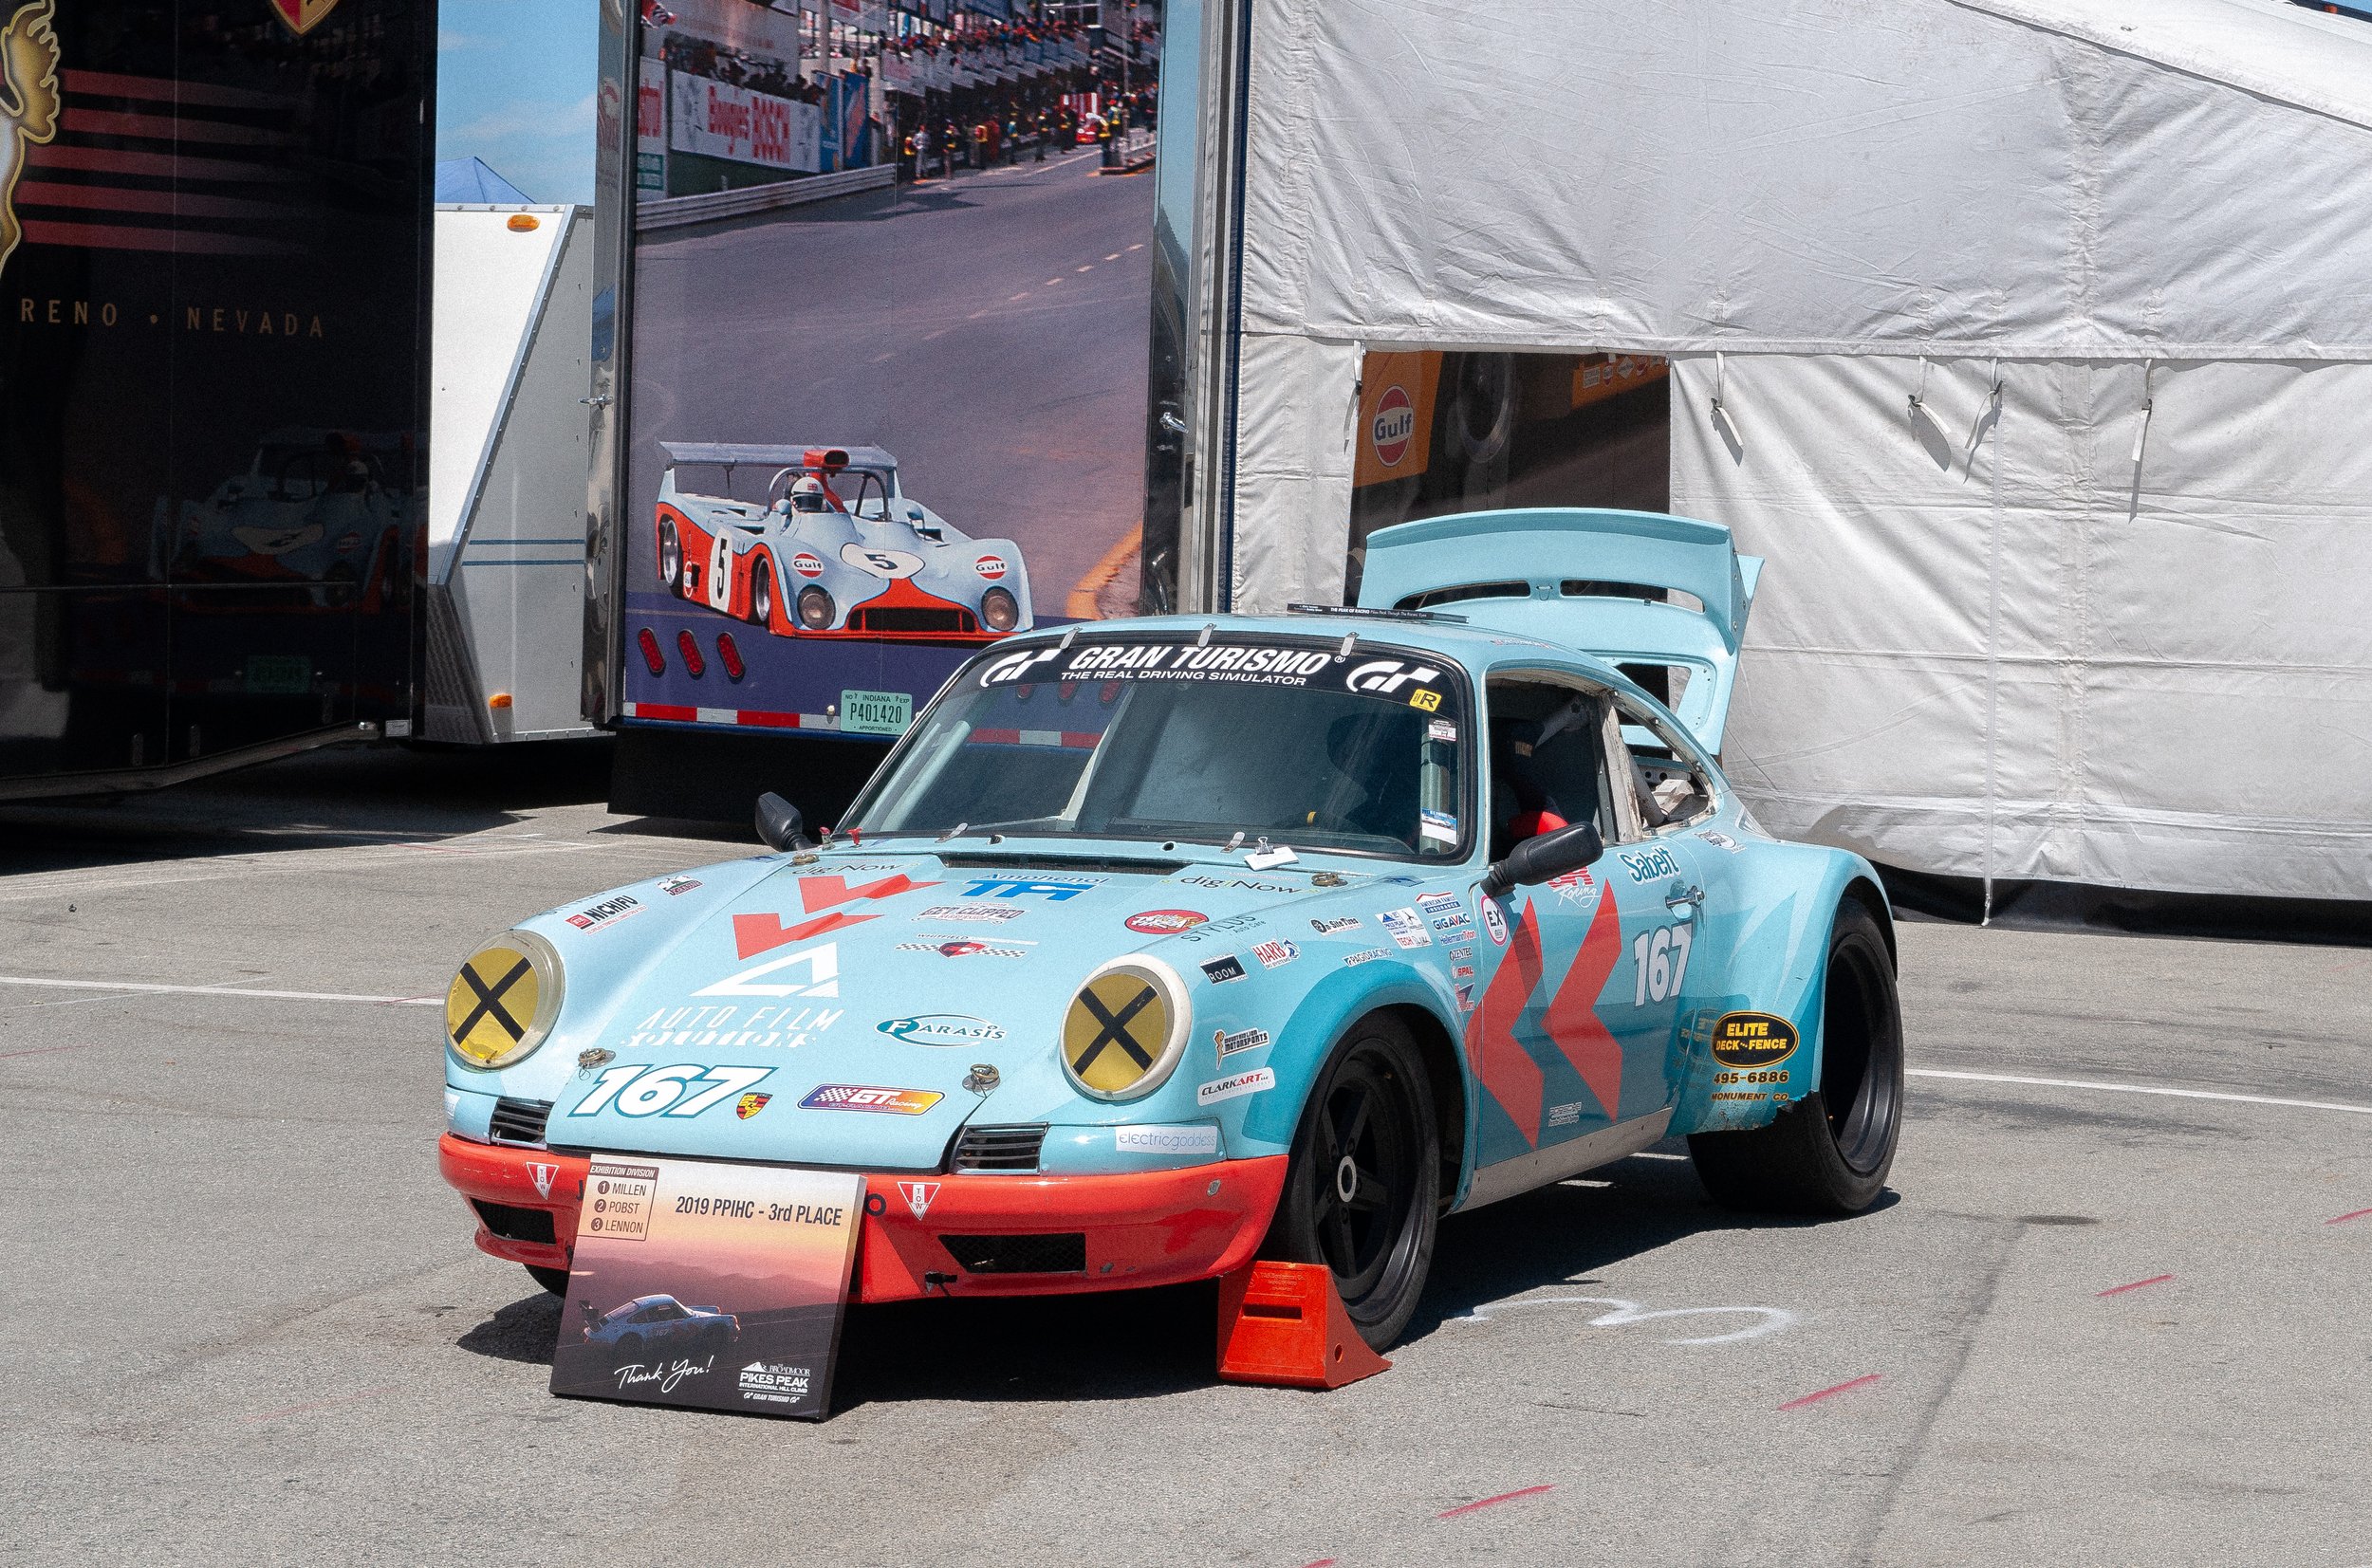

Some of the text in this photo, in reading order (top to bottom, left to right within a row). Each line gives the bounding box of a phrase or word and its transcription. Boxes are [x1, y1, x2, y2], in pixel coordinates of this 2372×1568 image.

[21, 299, 324, 339] RENO NEVADA
[1375, 414, 1412, 441] Gulf
[716, 538, 728, 600] 5
[793, 560, 823, 571] Gulf
[864, 553, 899, 571] 5
[975, 562, 1007, 572] Gulf
[1069, 646, 1332, 675] GRAN TURISMO
[1061, 670, 1307, 686] THE REAL DRIVING SIMULATOR
[862, 694, 891, 703] INDIANA
[1419, 692, 1436, 709] R
[849, 702, 902, 724] P401420
[1619, 846, 1679, 882] Sabelt
[978, 873, 1110, 884] Amphenol
[583, 895, 639, 922] NICHIFU
[919, 906, 1025, 919] GET CLIPPED
[1426, 902, 1459, 913] INSURANCE
[1233, 920, 1267, 934] Auto Care
[1433, 913, 1471, 931] GIGAVAC
[1486, 909, 1503, 927] EX
[1180, 915, 1256, 942] STYLUS
[1252, 941, 1287, 965] HARB
[1633, 919, 1694, 1007] 167
[1208, 967, 1237, 982] ROOM
[636, 1005, 845, 1031] AUTO FILM
[885, 1020, 1006, 1040] FARASIS
[1726, 1022, 1770, 1037] ELITE
[1224, 1032, 1268, 1052] MOTORSPORTS
[1715, 1038, 1788, 1051] DECK FENCE
[1201, 1072, 1263, 1097] CLARKART
[1714, 1070, 1789, 1085] 495-6886
[566, 1062, 780, 1119] 167
[847, 1089, 924, 1110] GT Racing
[1711, 1092, 1788, 1101] MONUMENT CO
[1119, 1132, 1215, 1151] electricgoddess
[589, 1165, 656, 1178] EXHIBITION DIVISION
[612, 1182, 647, 1196] MILLEN
[608, 1201, 640, 1214] POBST
[915, 1188, 923, 1209] TOW
[676, 1195, 710, 1215] 2019
[713, 1198, 755, 1219] PPIHC
[768, 1203, 793, 1222] 3rd
[795, 1205, 843, 1227] PLACE
[604, 1219, 644, 1234] LENNON
[614, 1355, 714, 1393] Thank You!
[740, 1372, 809, 1388] PIKES PEAK
[738, 1382, 779, 1391] INTERNATIONAL
